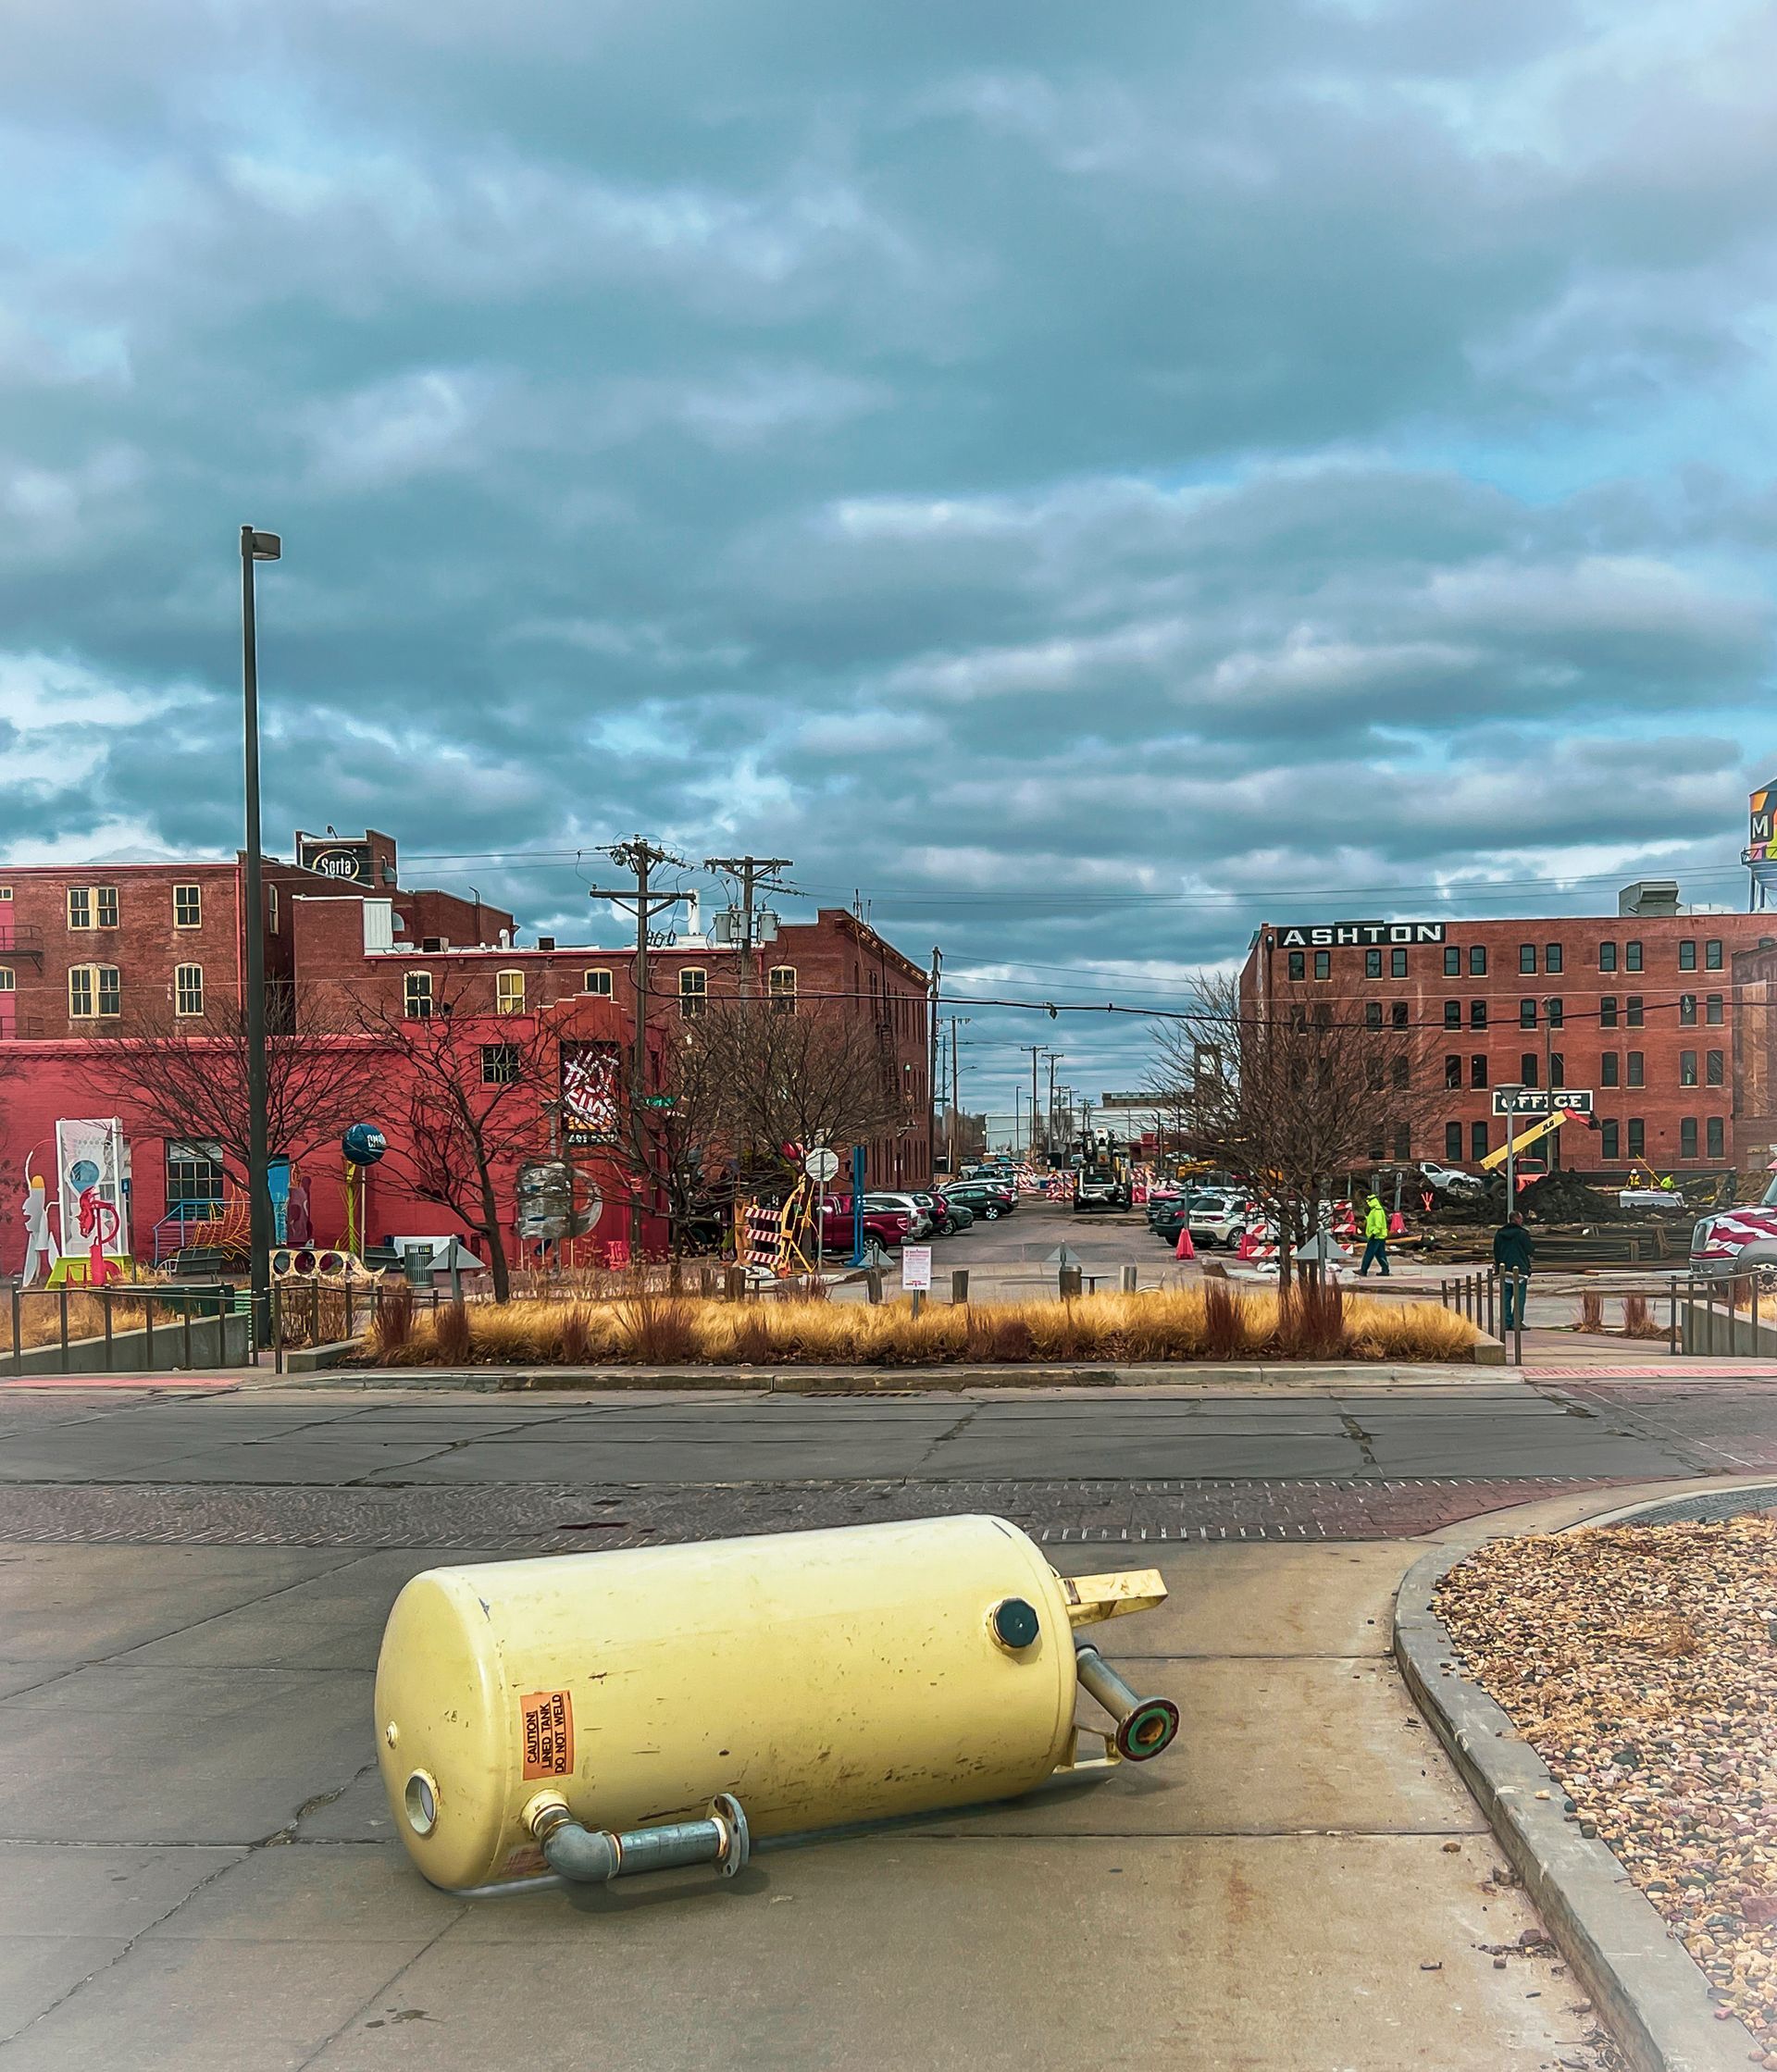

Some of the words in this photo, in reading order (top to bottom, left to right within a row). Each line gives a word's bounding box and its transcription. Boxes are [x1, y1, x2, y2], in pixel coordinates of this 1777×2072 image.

[321, 857, 352, 875] Serta
[1283, 925, 1441, 946] ASHTON
[1542, 1120, 1555, 1132] JLG
[540, 1702, 551, 1733] TANK
[553, 1694, 564, 1727] WELD
[541, 1736, 552, 1768] LINED
[554, 1731, 565, 1754] NOT
[554, 1756, 565, 1773] DO
